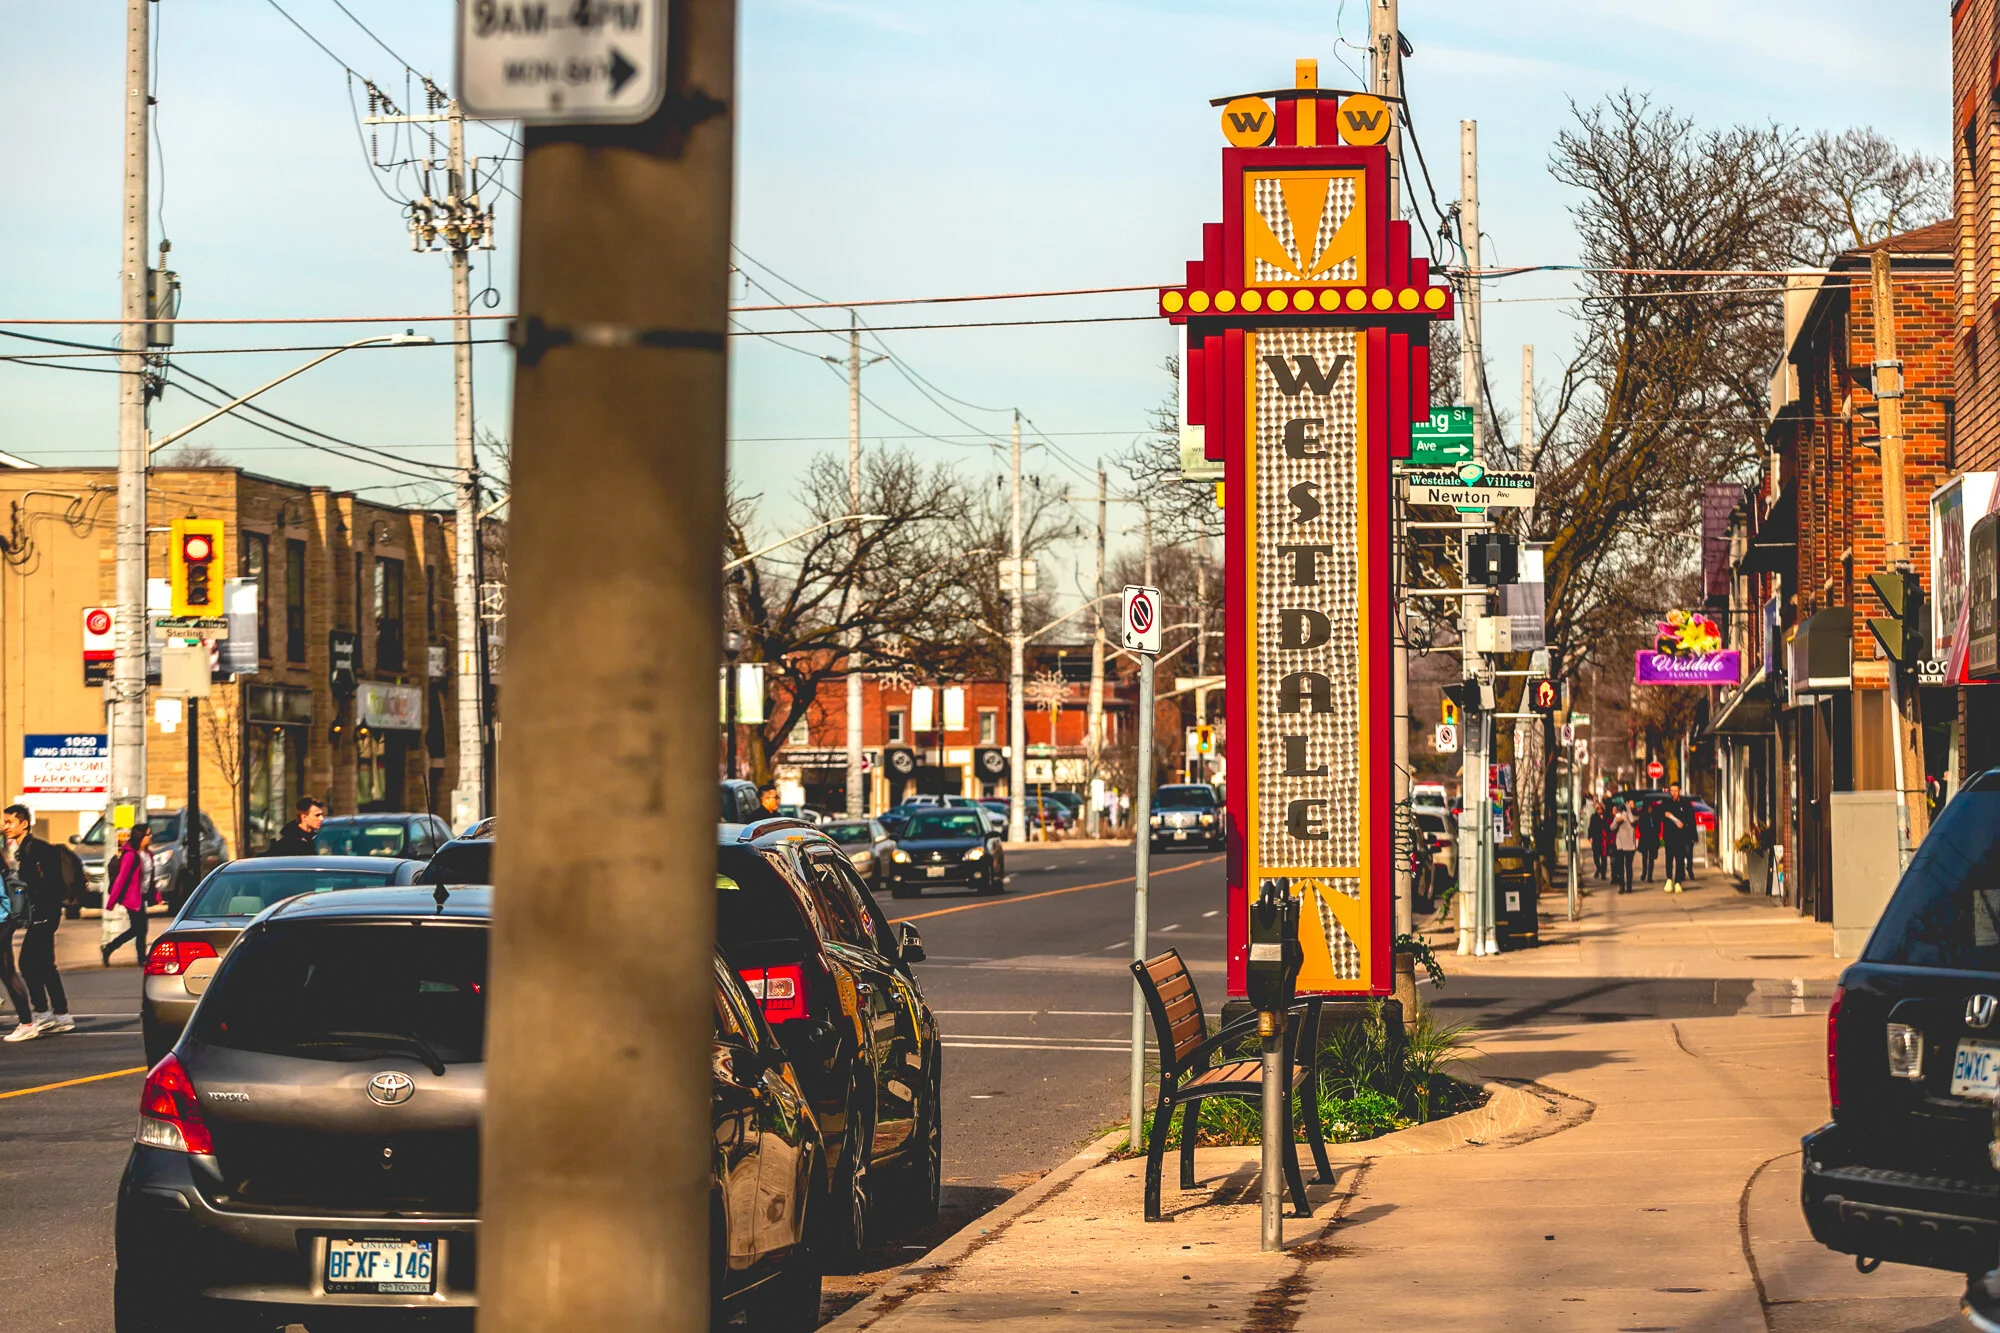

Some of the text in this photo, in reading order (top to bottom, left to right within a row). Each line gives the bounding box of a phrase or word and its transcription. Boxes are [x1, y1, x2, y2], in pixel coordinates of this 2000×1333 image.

[1227, 112, 1267, 132] W
[1343, 110, 1383, 131] W
[1453, 409, 1466, 421] St
[1416, 440, 1437, 452] Ave
[1411, 474, 1531, 489] Westdale Village
[1428, 488, 1510, 503] Newton Ave
[1261, 354, 1350, 841] WESTDALE
[166, 628, 204, 639] Sterling
[64, 736, 97, 747] 1050
[33, 747, 59, 757] KING
[59, 747, 97, 757] STREET
[207, 1091, 250, 1102] TOYOTA
[361, 1241, 404, 1250] ONTARIO
[330, 1251, 430, 1279] BFXF 146
[394, 1284, 428, 1292] TOYOTA
